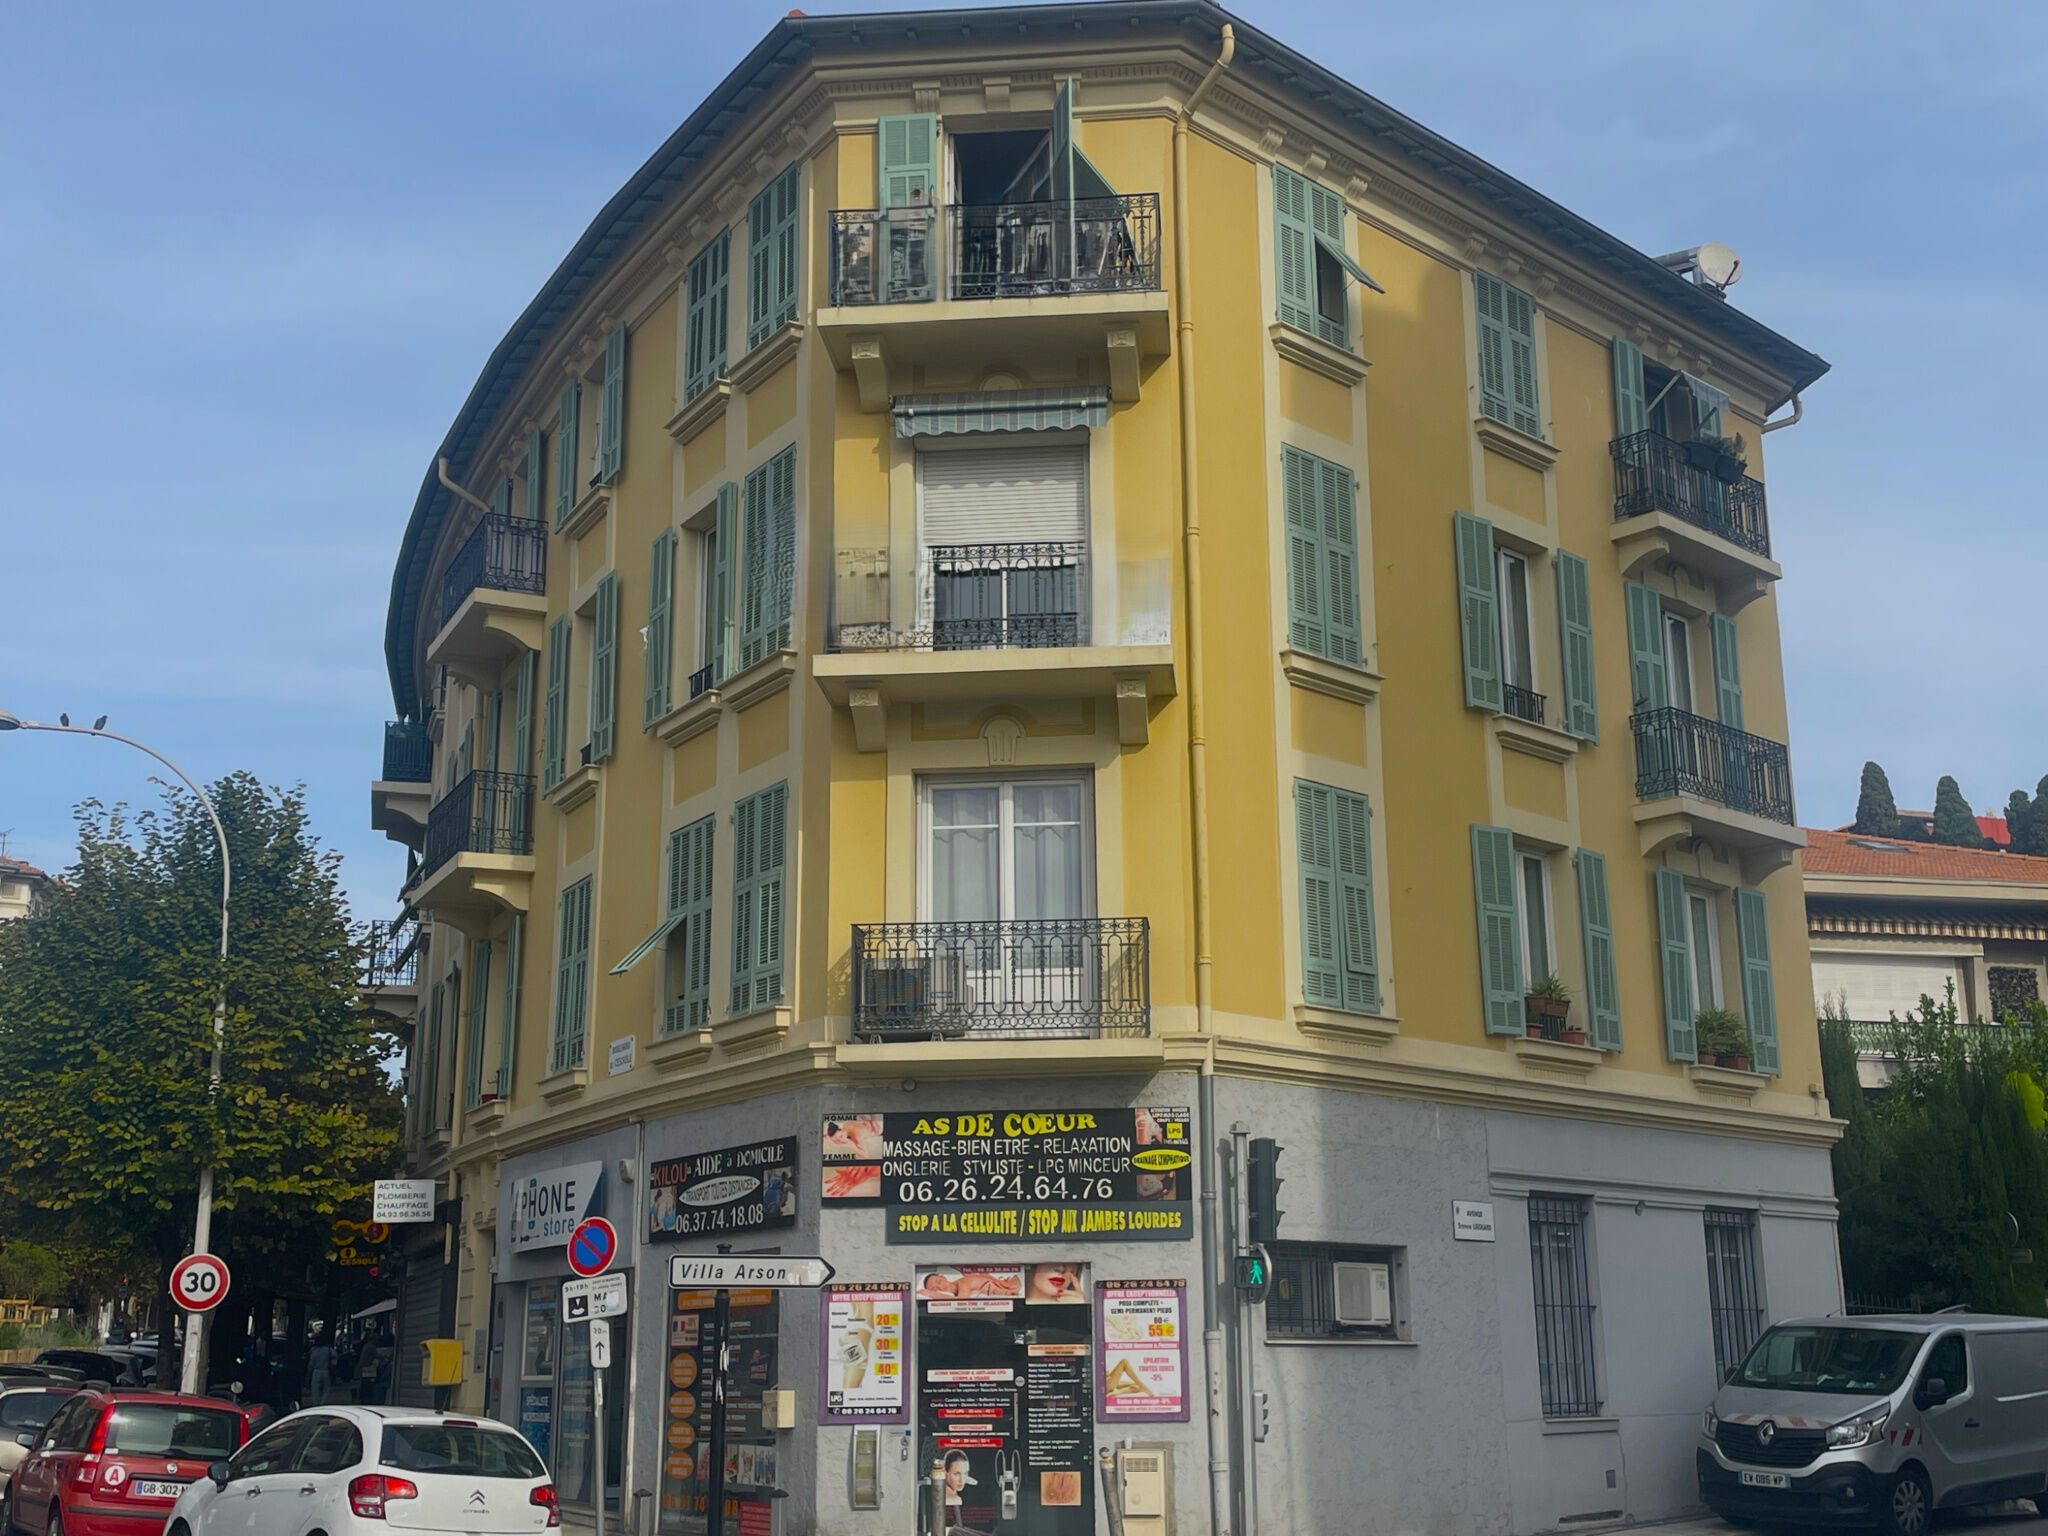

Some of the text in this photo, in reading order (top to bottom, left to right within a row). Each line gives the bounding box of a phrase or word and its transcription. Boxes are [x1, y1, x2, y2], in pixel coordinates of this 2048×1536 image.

[912, 1118, 950, 1135] AS
[956, 1114, 995, 1137] DE
[994, 1138, 1030, 1156] ETRE
[1043, 1137, 1131, 1154] RELAXATION
[654, 1162, 688, 1187] KILOU
[694, 1154, 722, 1177] AIDE
[736, 1144, 784, 1168] DOMICILE
[883, 1160, 950, 1176] ONGLERIE
[963, 1159, 1024, 1176] STYLISTE
[1038, 1159, 1064, 1174] LPG
[1068, 1157, 1131, 1174] MINCEUR
[377, 1192, 427, 1200] PLOMBERIE
[899, 1175, 1113, 1202] 06.26.24.64.76
[543, 1217, 575, 1237] store
[676, 1203, 764, 1234] 06.37.74.18.08
[899, 1215, 929, 1232] STOP
[931, 1213, 940, 1231] A
[943, 1213, 957, 1232] LA
[960, 1210, 1017, 1234] CELLULITE
[1028, 1209, 1058, 1235] STOP
[1061, 1209, 1077, 1233] AUX
[1081, 1210, 1126, 1232] JAMBES
[1128, 1211, 1182, 1230] LOURDES
[681, 1264, 786, 1279] Villa Arson
[184, 1272, 216, 1293] 30
[865, 1283, 878, 1291] 24
[896, 1282, 910, 1290] 76
[876, 1314, 889, 1325] 20
[1148, 1324, 1162, 1337] 55
[876, 1338, 889, 1350] 30
[877, 1363, 890, 1375] 40
[109, 1468, 119, 1482] A
